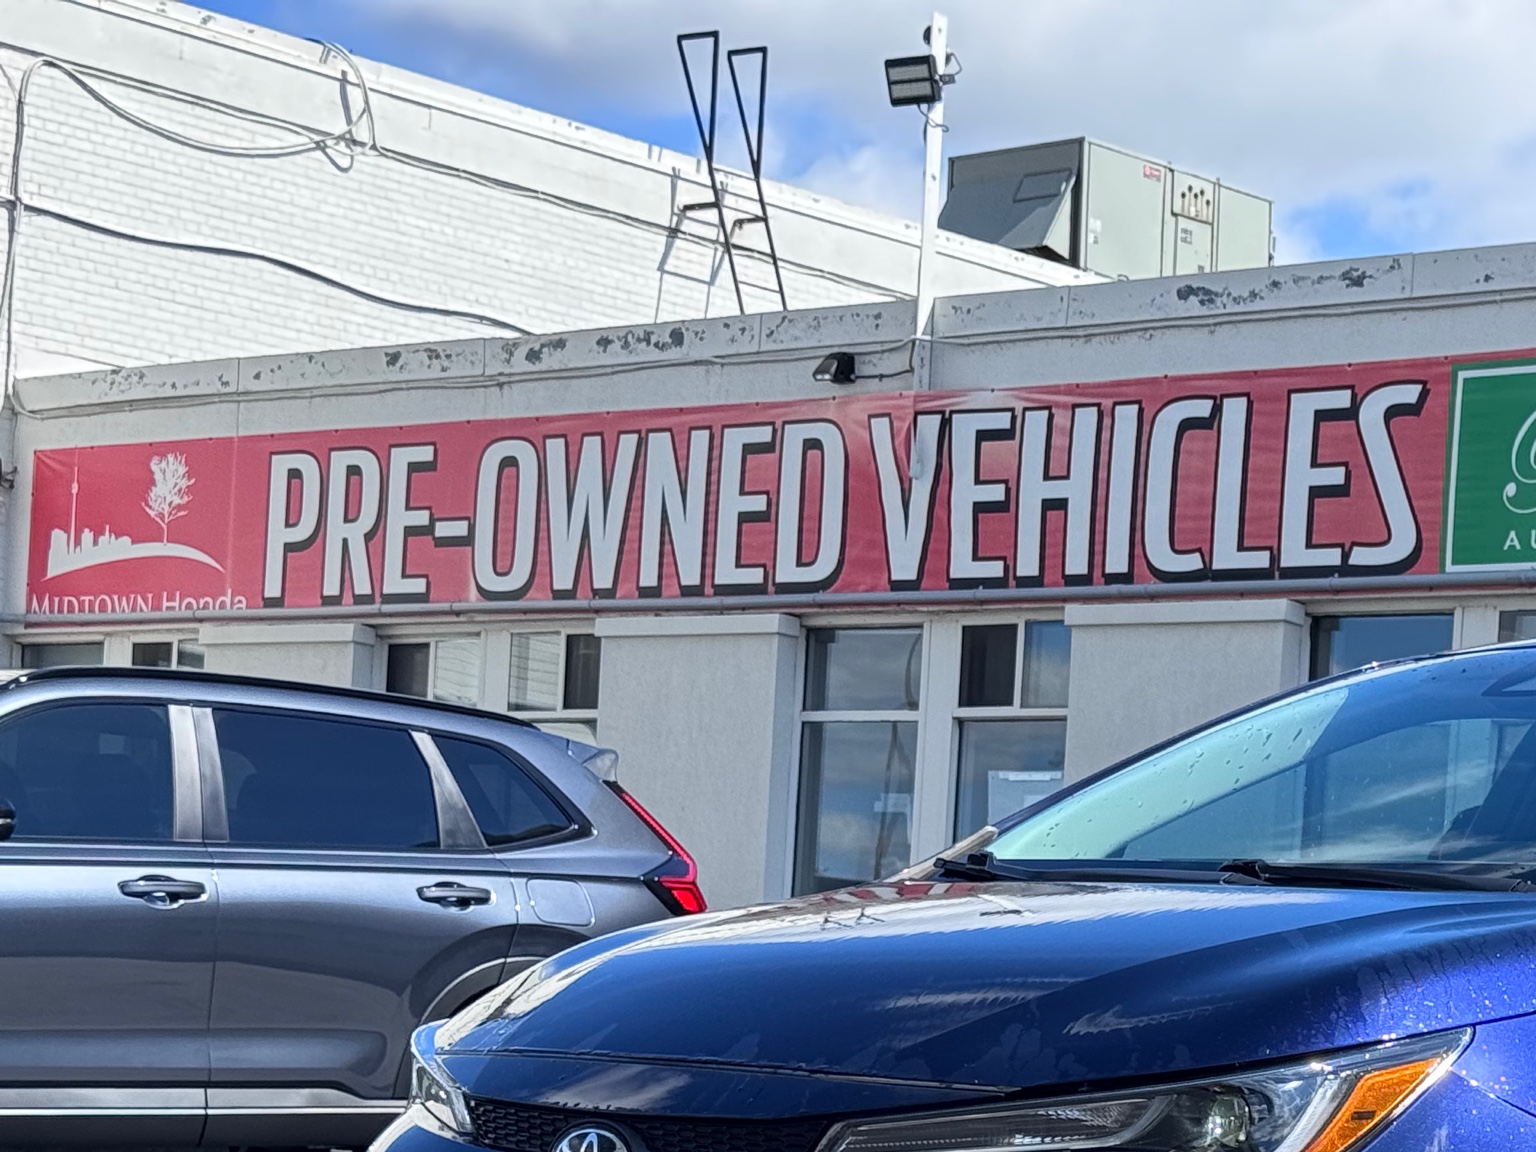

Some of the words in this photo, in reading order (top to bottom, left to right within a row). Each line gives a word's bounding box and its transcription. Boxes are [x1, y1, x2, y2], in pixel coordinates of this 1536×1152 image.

[262, 418, 848, 606] PRE-OWNED
[868, 379, 1428, 590] VEHICLES
[31, 592, 154, 614] MIDTOWN
[162, 588, 247, 611] Honda
